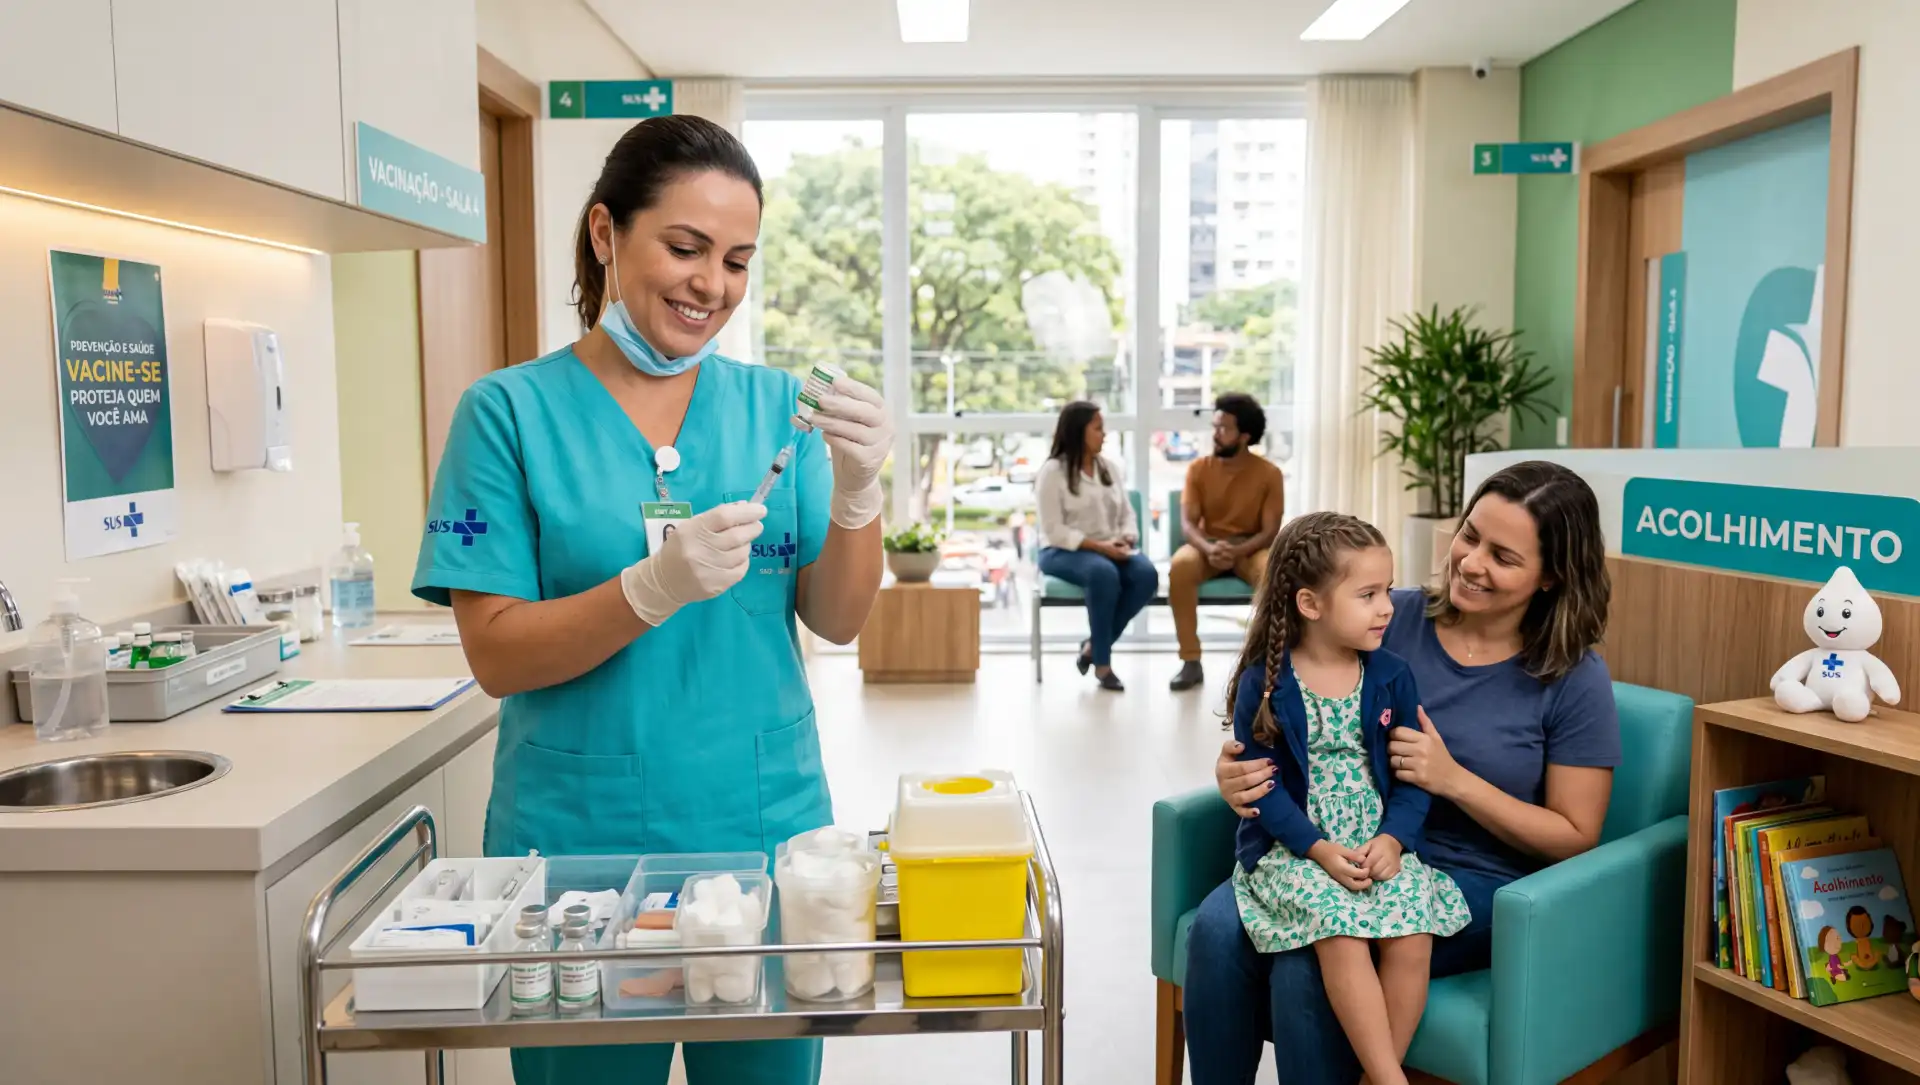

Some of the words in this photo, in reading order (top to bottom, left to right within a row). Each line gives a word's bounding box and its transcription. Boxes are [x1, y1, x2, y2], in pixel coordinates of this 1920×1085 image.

[559, 91, 572, 108] 4
[1481, 151, 1492, 167] 3
[368, 155, 439, 205] VACINAÇÃO
[446, 185, 473, 215] SALA
[473, 196, 480, 217] 4
[122, 343, 128, 354] E
[128, 341, 155, 355] SAÚDE
[66, 359, 162, 383] VACINE-SE
[70, 388, 126, 405] PROTEJA
[127, 388, 161, 407] QUEM
[86, 407, 121, 426] VOCÊ
[122, 409, 149, 425] AMA
[103, 515, 122, 531] SUS
[427, 519, 451, 534] SUS
[1636, 505, 1903, 564] ACOLHIMENTO
[751, 543, 777, 558] SUS
[1821, 670, 1841, 679] SUS
[1813, 874, 1884, 894] Acolhimento
